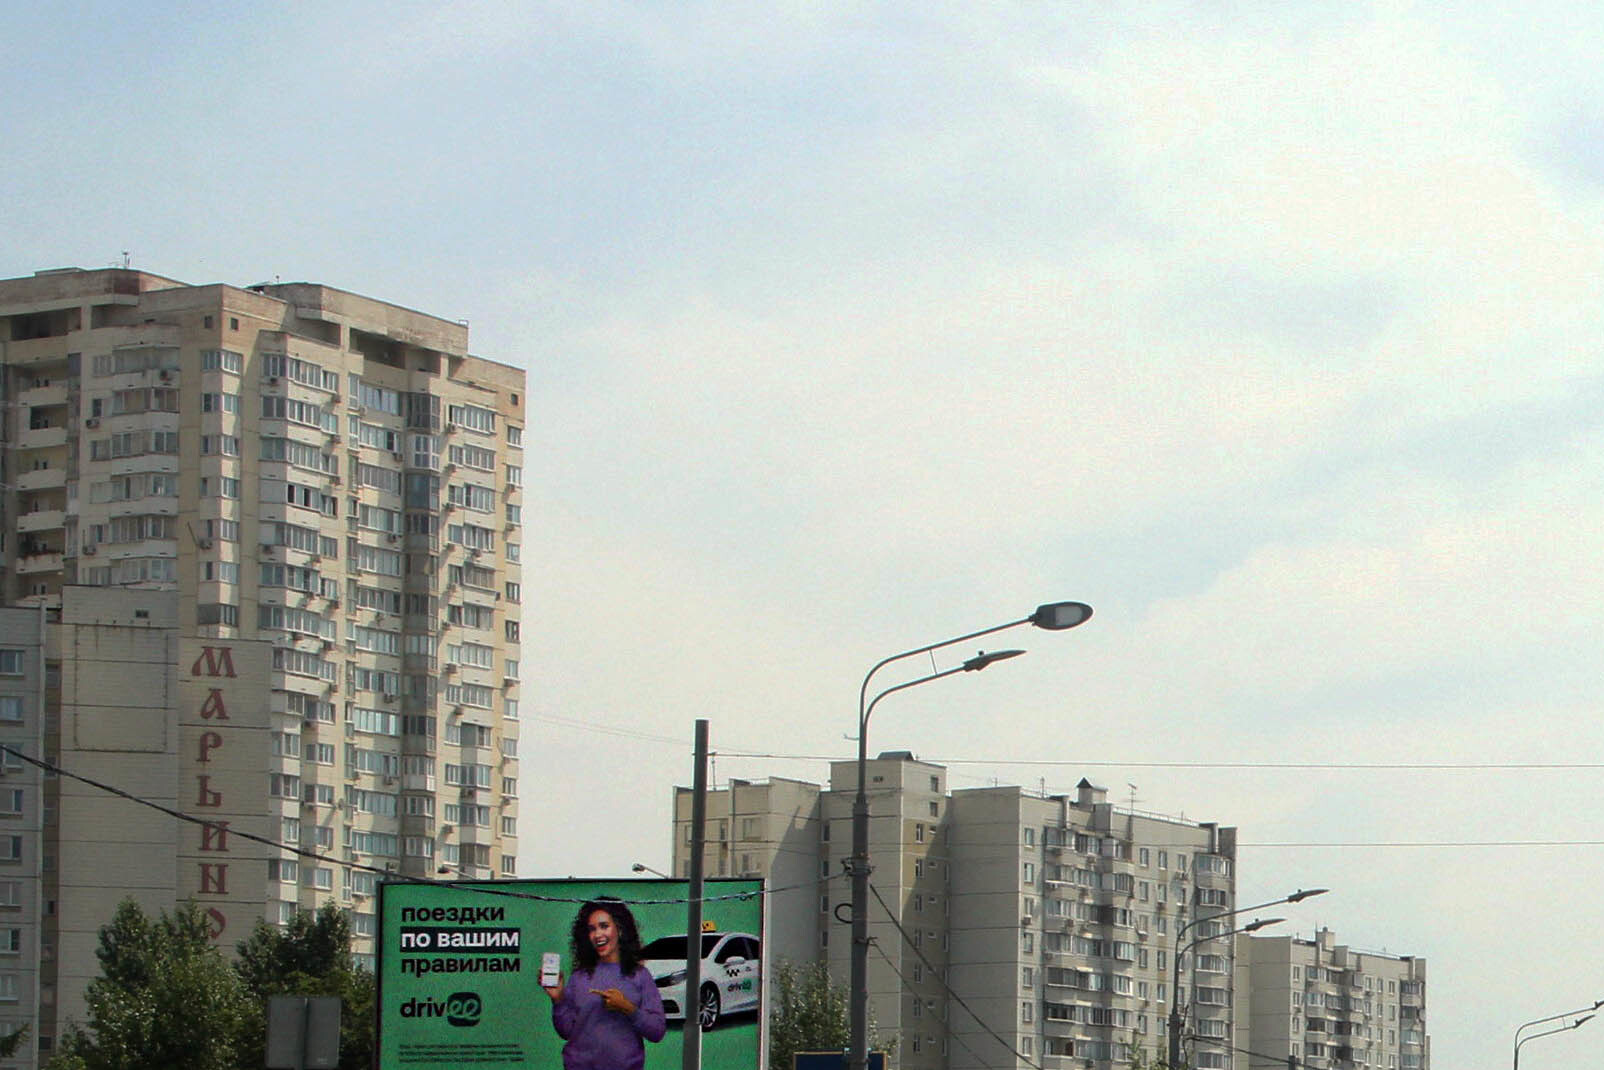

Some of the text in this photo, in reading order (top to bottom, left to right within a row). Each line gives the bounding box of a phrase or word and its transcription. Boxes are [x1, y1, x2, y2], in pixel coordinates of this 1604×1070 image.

[400, 907, 505, 925] поездки
[401, 932, 519, 948] по вашим
[401, 958, 521, 978] правилам
